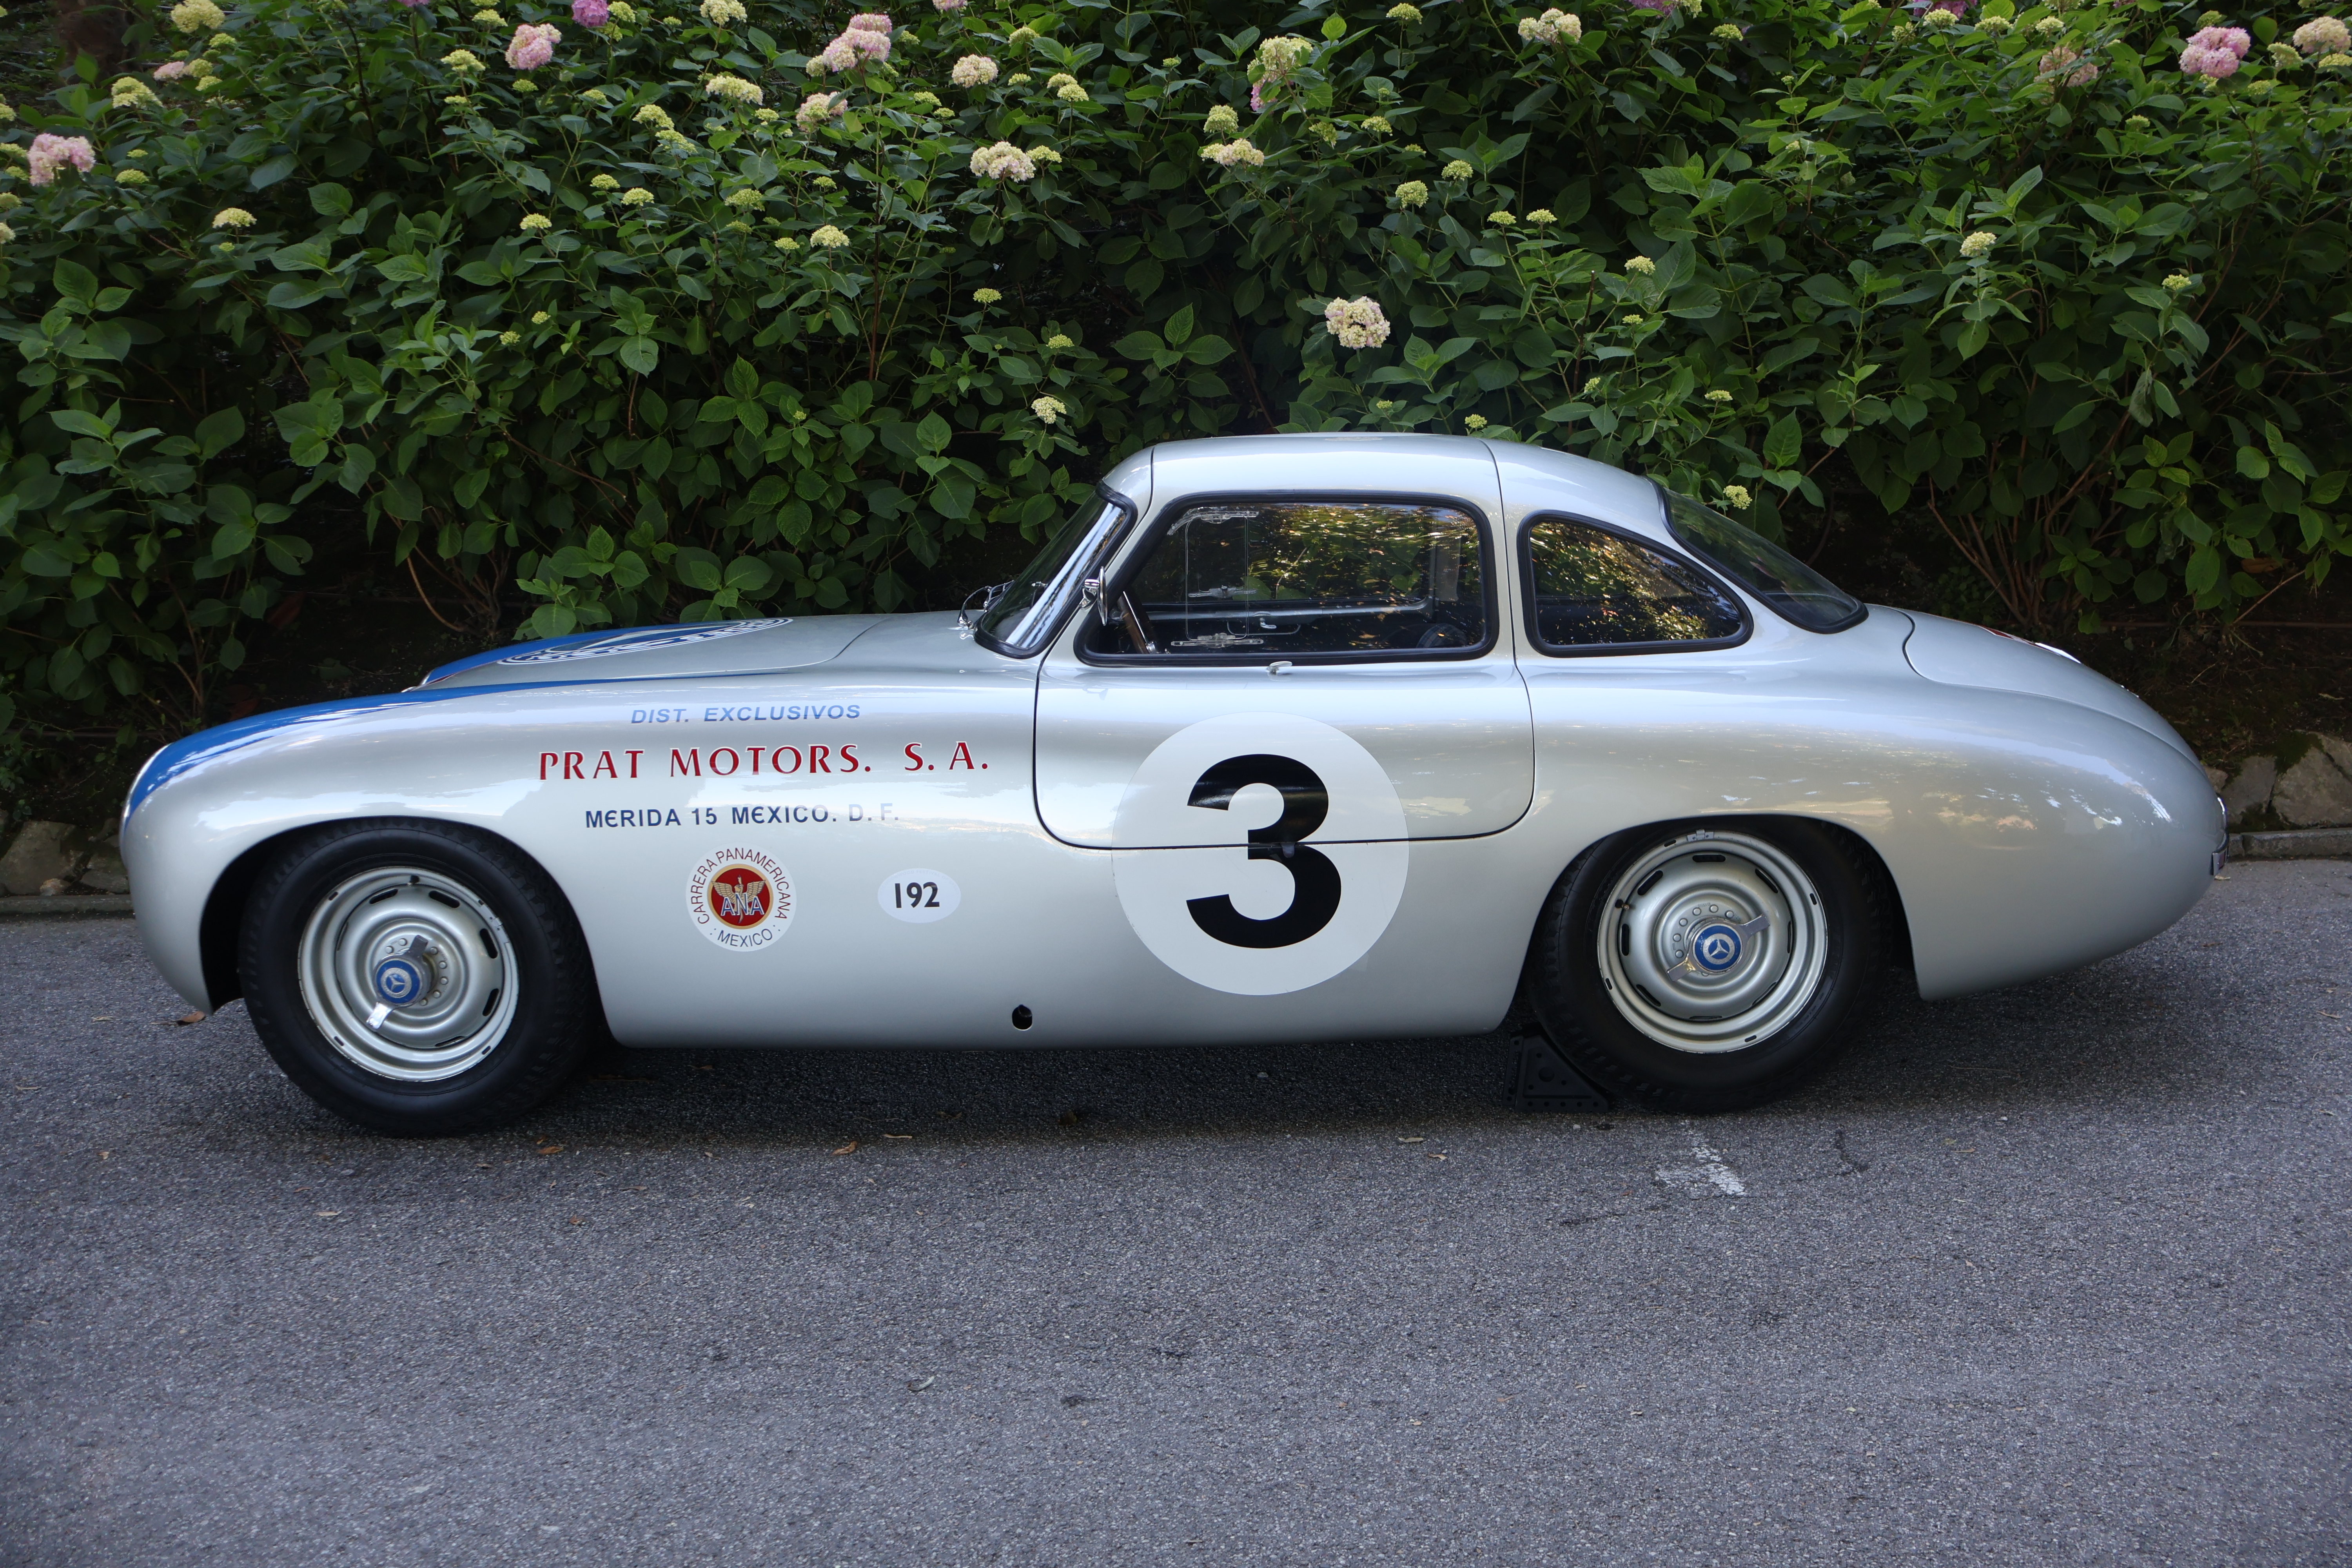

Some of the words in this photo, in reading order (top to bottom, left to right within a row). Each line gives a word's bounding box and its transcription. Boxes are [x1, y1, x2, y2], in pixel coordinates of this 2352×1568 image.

[679, 619, 776, 641] CEDES
[630, 708, 689, 723] DIST.
[702, 704, 860, 721] EXCLUSIVOS
[540, 750, 644, 780] PRAT
[670, 744, 871, 777] MOTORS.
[585, 808, 681, 828] MERIDA
[691, 807, 717, 825] 15
[731, 805, 837, 824] MEXICO.
[1186, 753, 1341, 949] 3
[690, 858, 718, 924] CARRERA
[715, 847, 791, 920] PANAMERICANA
[895, 882, 940, 909] 192
[720, 892, 765, 916] ANA
[717, 928, 773, 947] MEXICO
